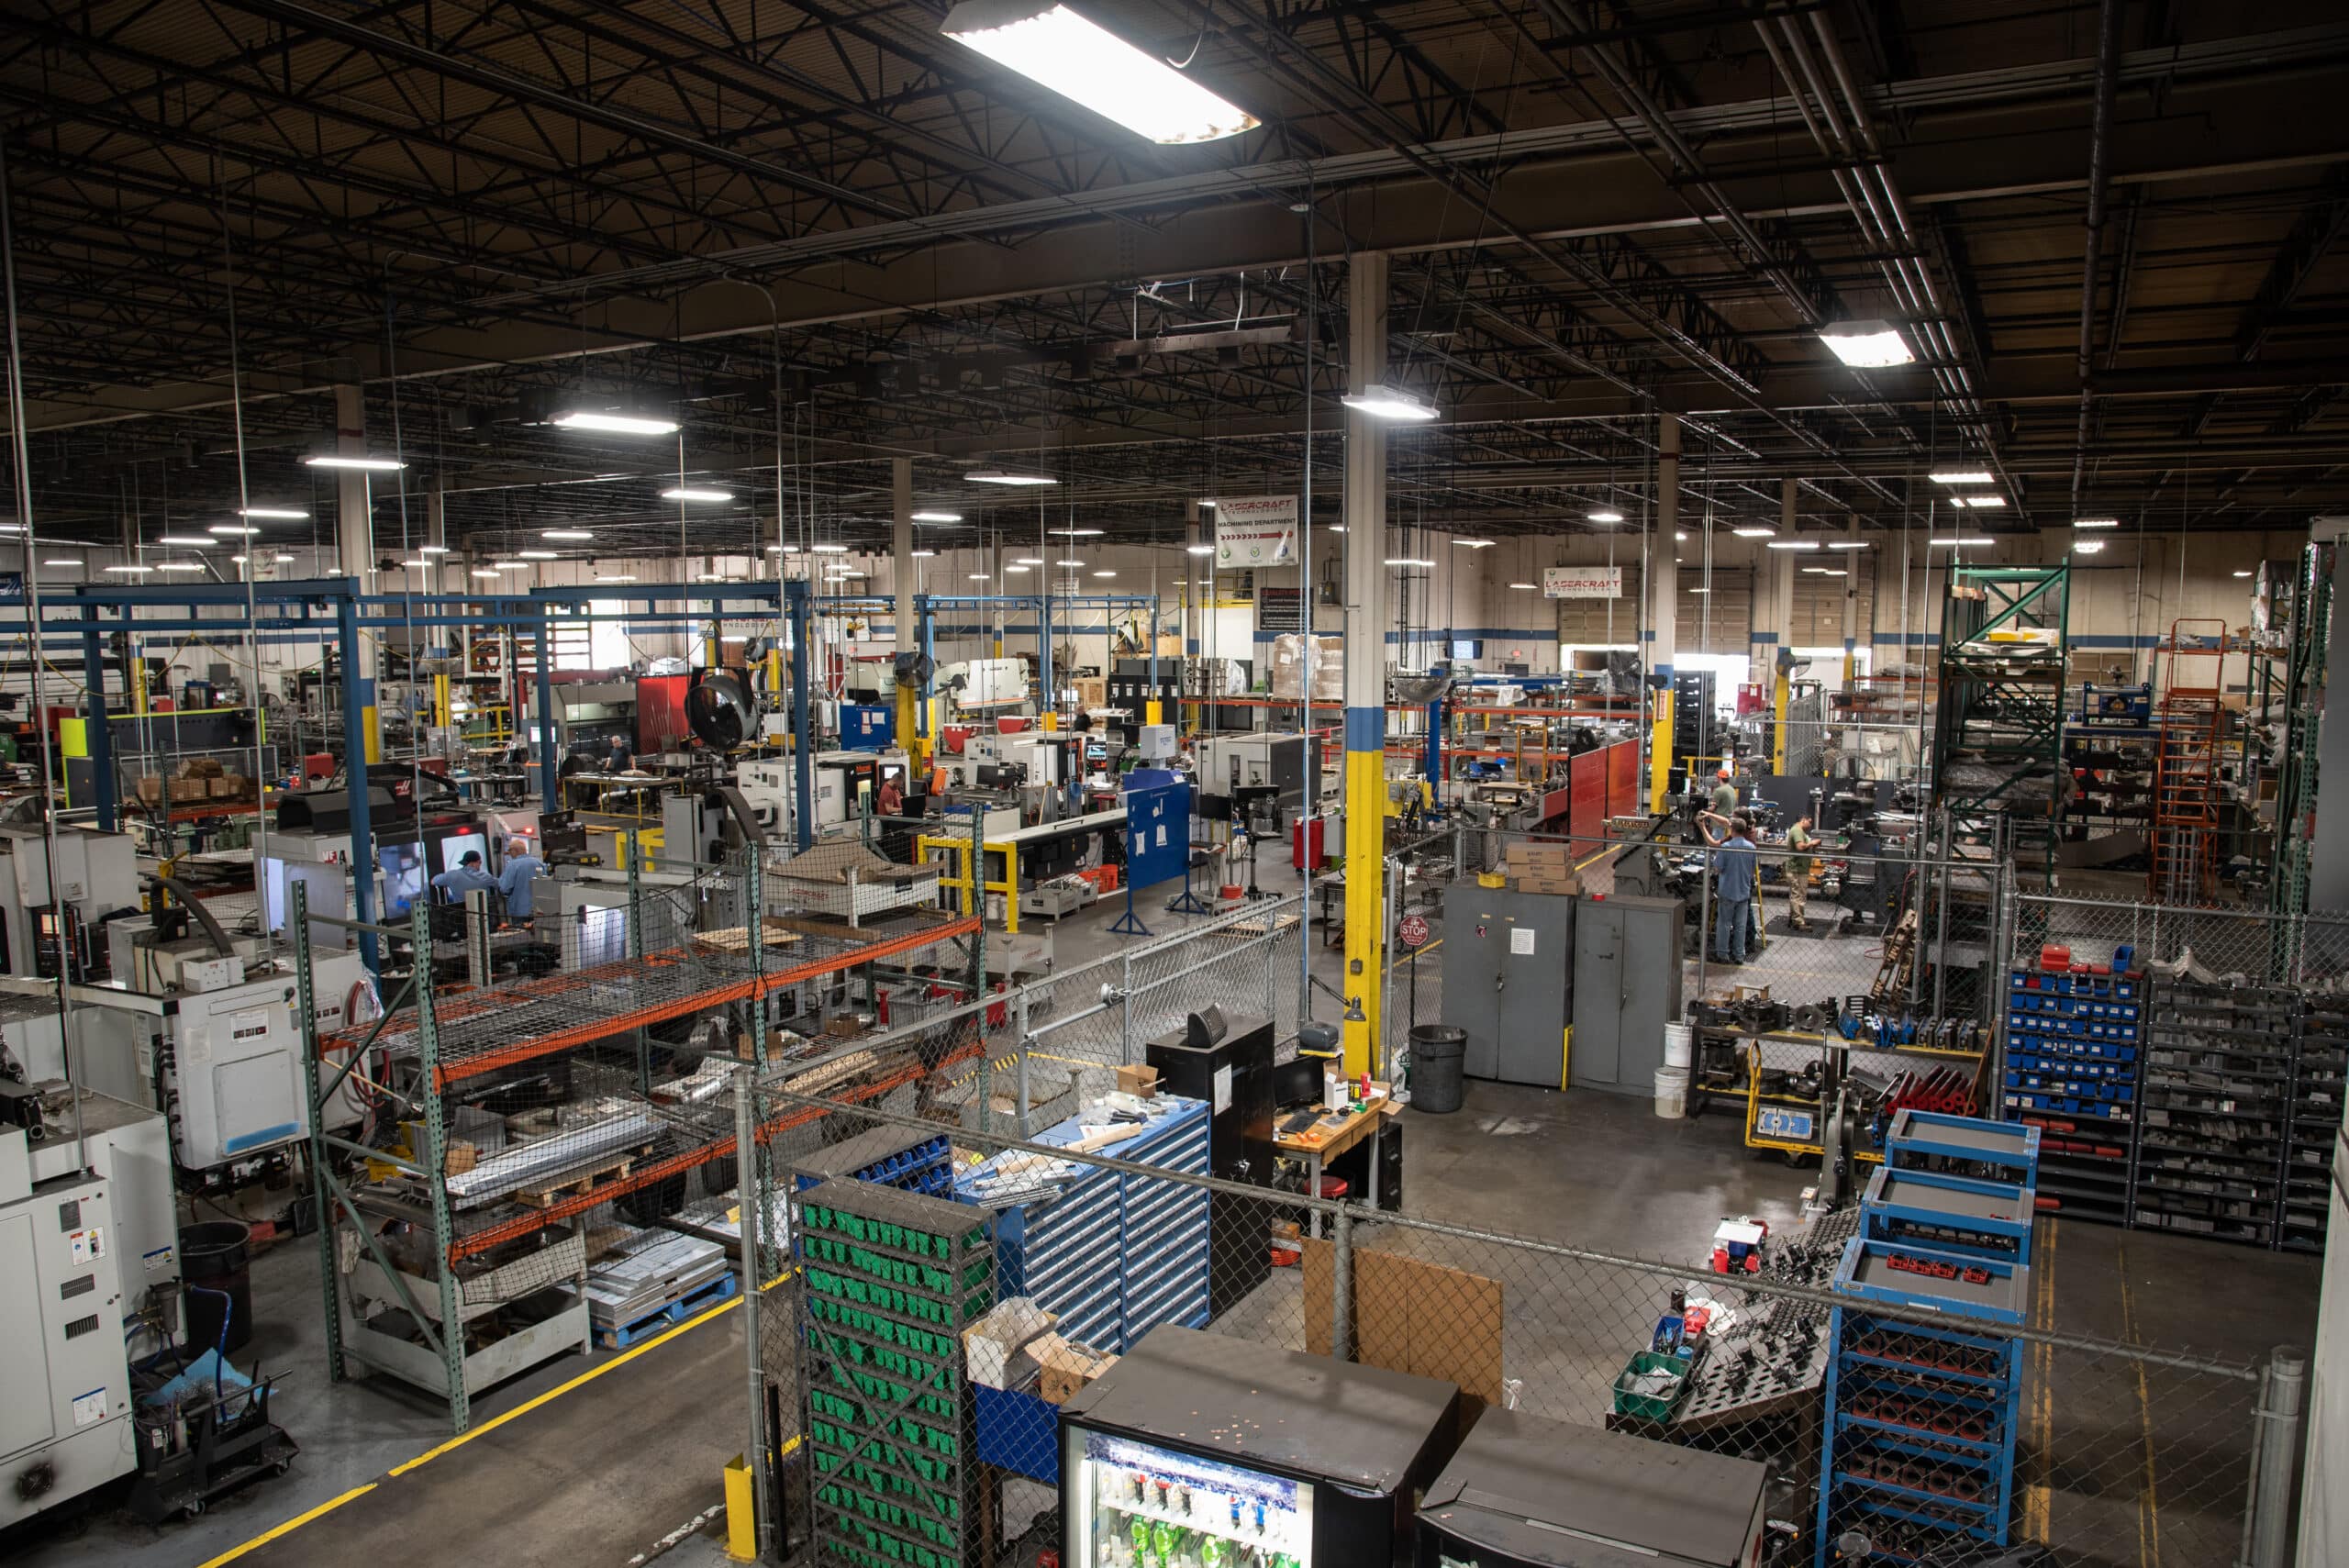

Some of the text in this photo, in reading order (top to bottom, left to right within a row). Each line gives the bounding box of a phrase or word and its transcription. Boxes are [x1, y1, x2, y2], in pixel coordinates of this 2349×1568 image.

[1220, 500, 1292, 511] LASERCRAFT
[1254, 517, 1296, 527] DEPARTMENT
[1402, 925, 1426, 936] STOP
